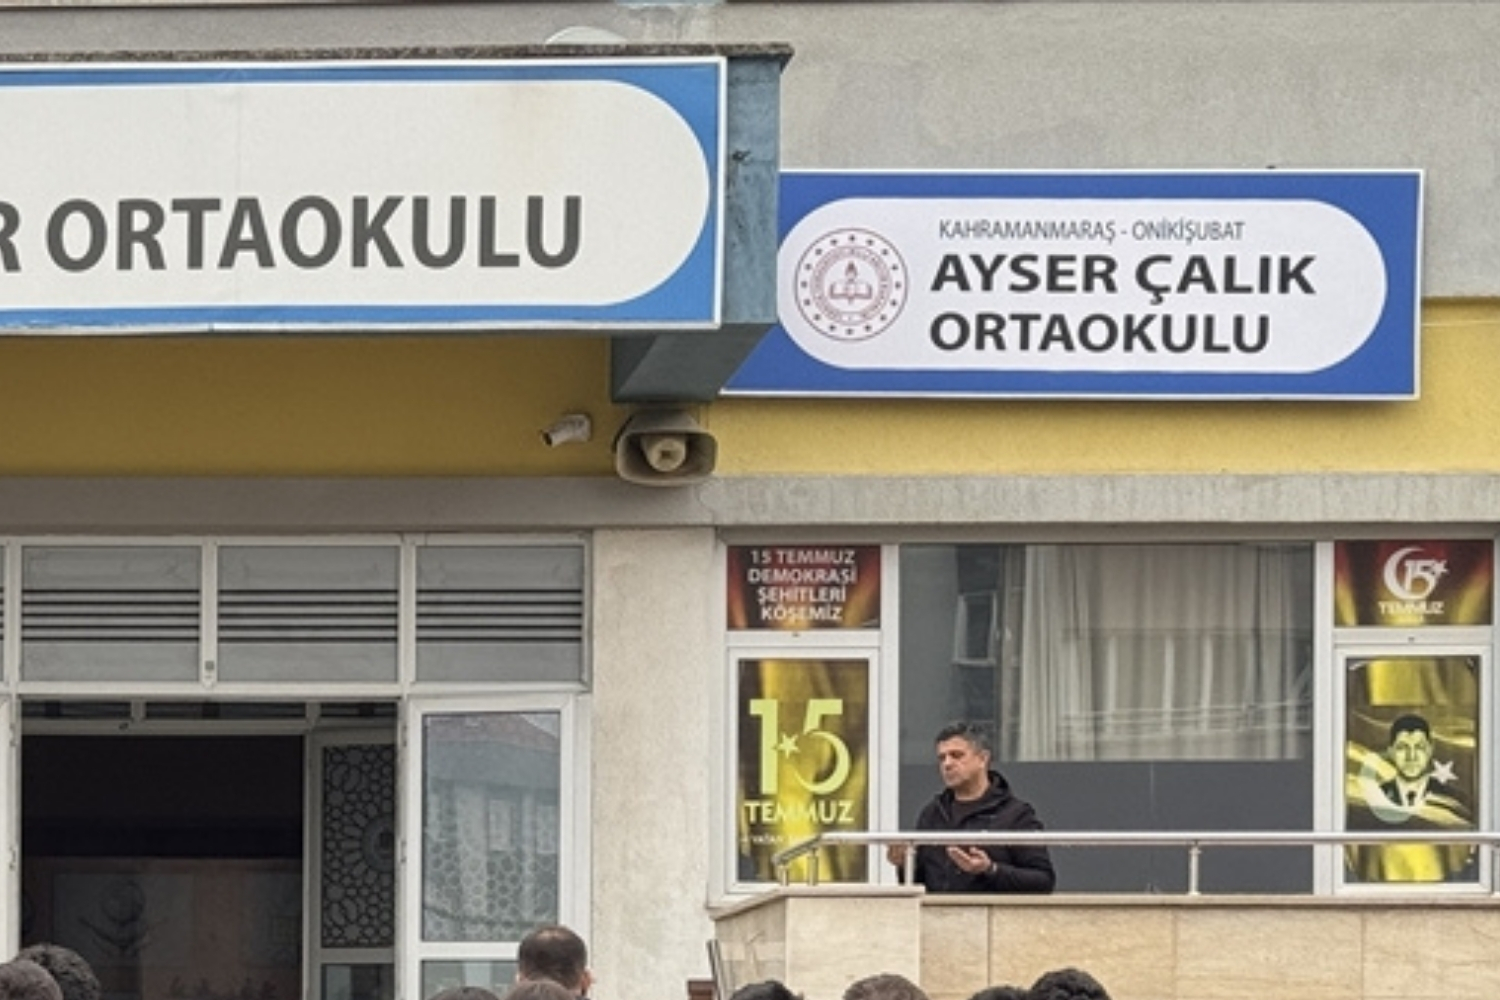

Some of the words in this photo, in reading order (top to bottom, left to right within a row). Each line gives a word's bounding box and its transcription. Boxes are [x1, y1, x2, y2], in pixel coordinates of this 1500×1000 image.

[46, 194, 581, 272] ORTAOKULU
[938, 218, 1116, 243] KAHRAMANMARAŞ
[1132, 217, 1245, 243] ONİKİŞUBAT
[930, 253, 1117, 294] AYSER
[1134, 254, 1316, 305] ÇALIK
[929, 311, 1270, 354] ORTAOKULU
[750, 549, 772, 565] 15
[776, 549, 856, 565] TEMMUZ
[749, 698, 851, 796] 15
